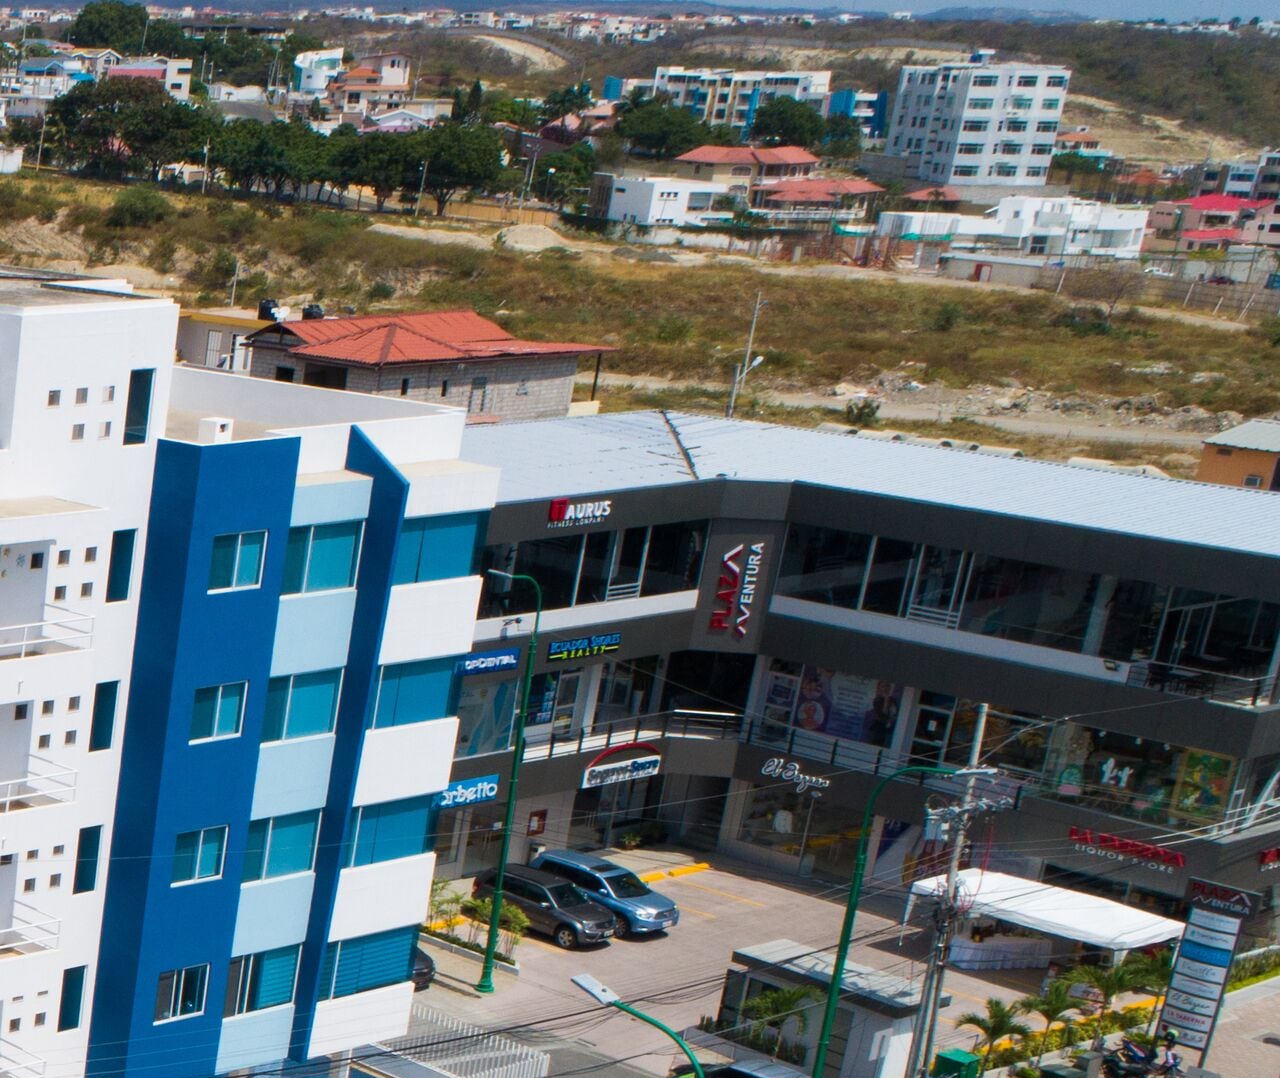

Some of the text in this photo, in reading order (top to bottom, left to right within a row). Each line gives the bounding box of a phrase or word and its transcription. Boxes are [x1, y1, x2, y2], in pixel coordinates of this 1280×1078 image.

[709, 543, 744, 631] PLAZA
[735, 542, 765, 638] AVENTURA
[1074, 844, 1175, 874] LIQUOR STORE
